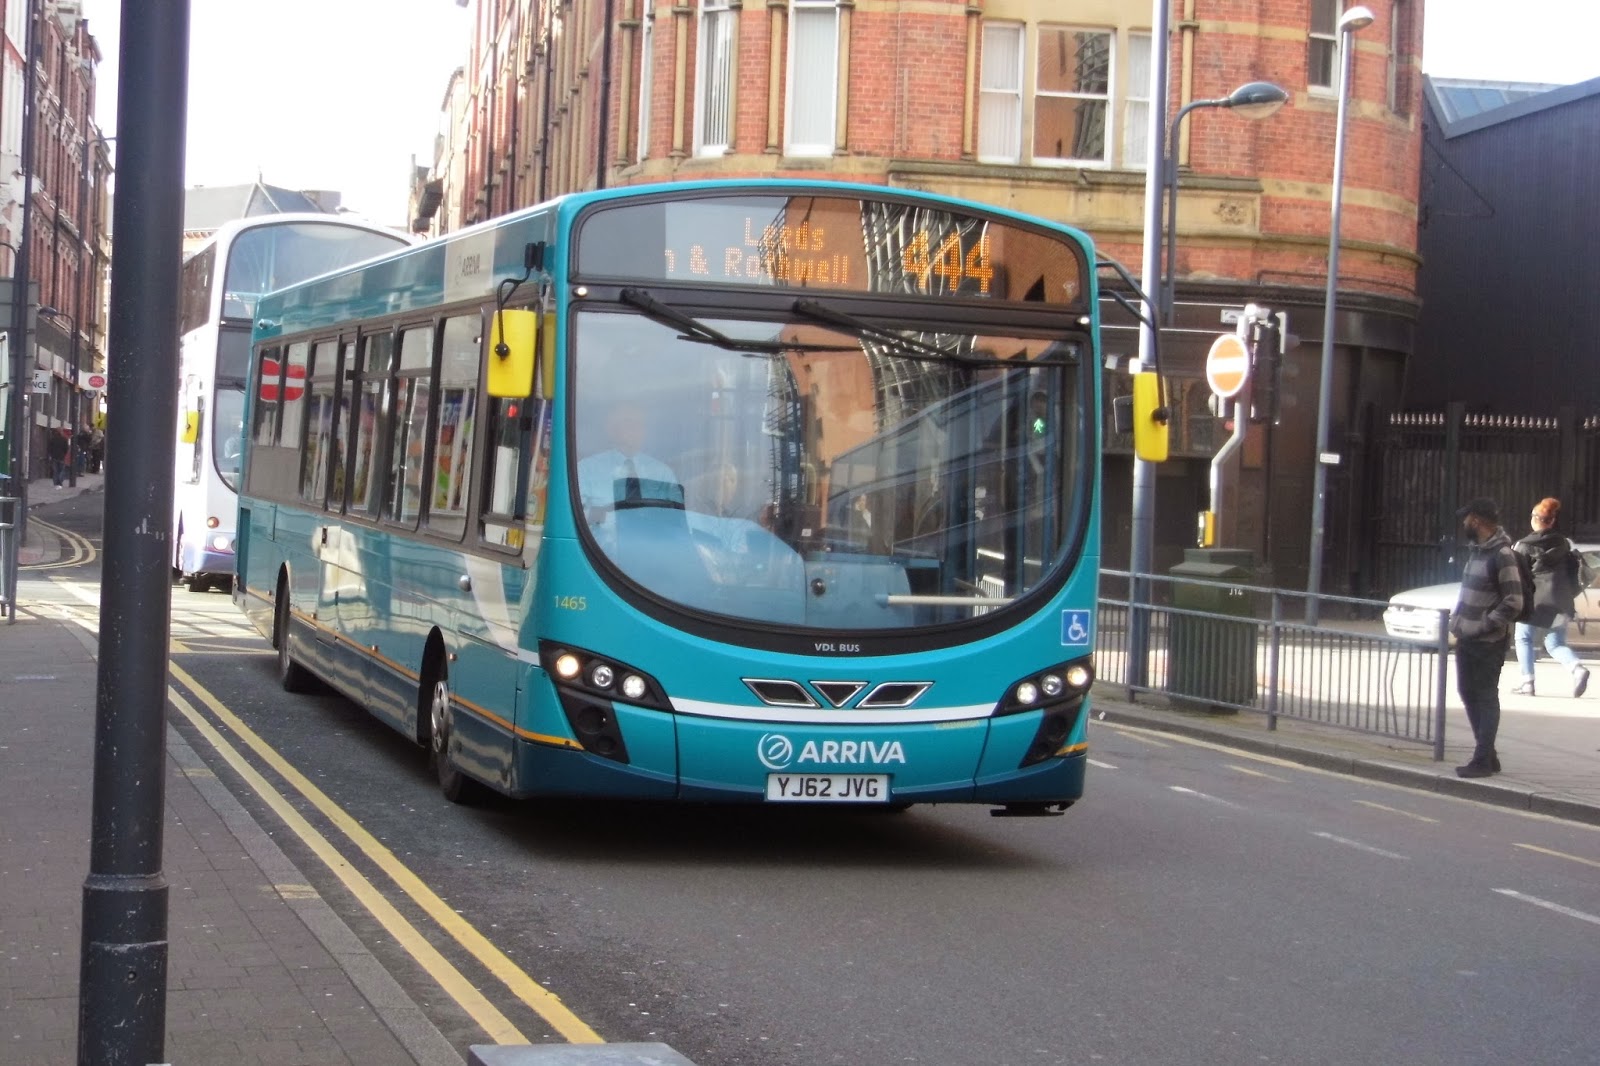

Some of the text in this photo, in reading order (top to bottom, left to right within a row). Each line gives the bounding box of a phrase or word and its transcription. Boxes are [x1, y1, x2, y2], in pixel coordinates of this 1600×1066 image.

[744, 216, 825, 251] Leeds
[690, 245, 709, 275] &
[724, 247, 849, 285] Rothwell
[902, 229, 994, 293] 444
[554, 595, 587, 611] 1465
[814, 643, 860, 653] VDL BUS
[797, 740, 906, 764] ARRIVA
[777, 777, 878, 798] YJ62 JVG
